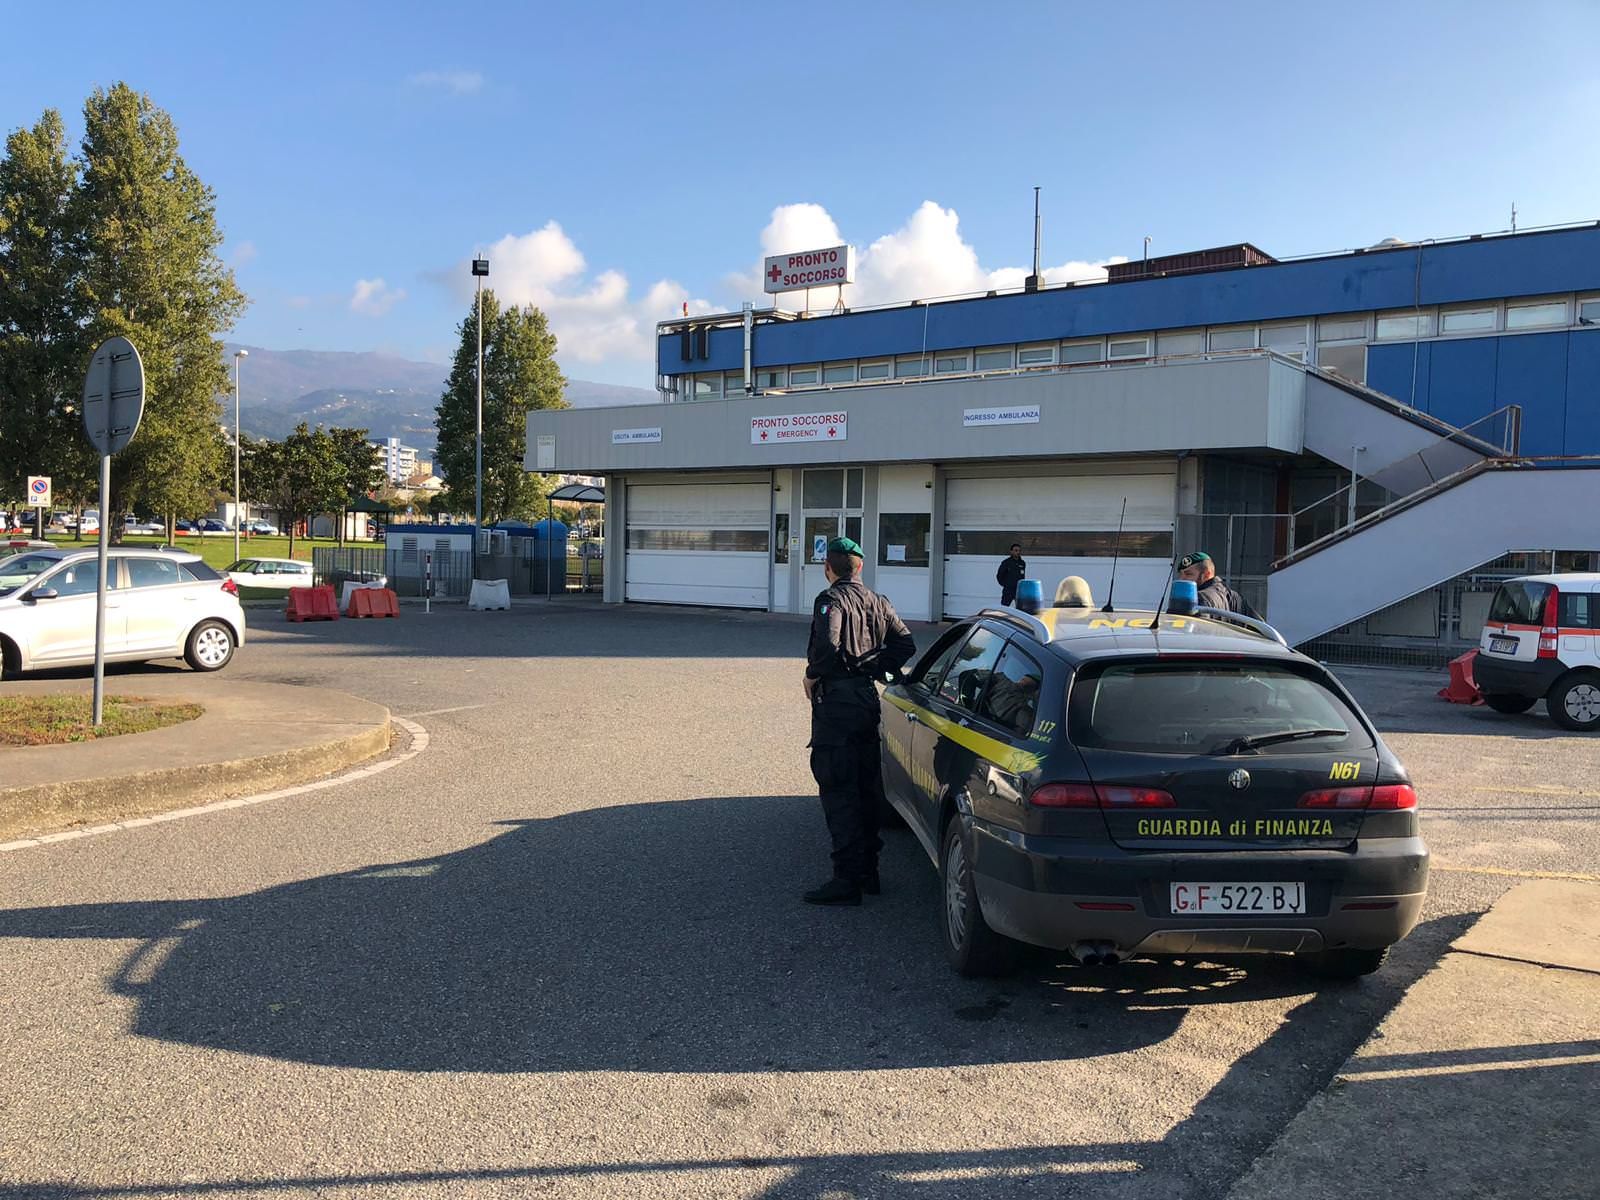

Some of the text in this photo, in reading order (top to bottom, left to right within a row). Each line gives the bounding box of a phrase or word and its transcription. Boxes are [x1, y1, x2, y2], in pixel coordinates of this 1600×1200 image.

[788, 251, 837, 268] PRONTO
[783, 267, 845, 286] SOCCORSO
[752, 413, 846, 429] PRONTO SOCCORSO
[963, 411, 1039, 421] INGRESSO AMBULANZA
[632, 431, 660, 439] AMBULANZA
[776, 429, 818, 438] EMERGENCY
[1038, 719, 1056, 734] 117
[1329, 761, 1361, 780] N61
[1137, 819, 1333, 836] GUARDIA di FINANZA
